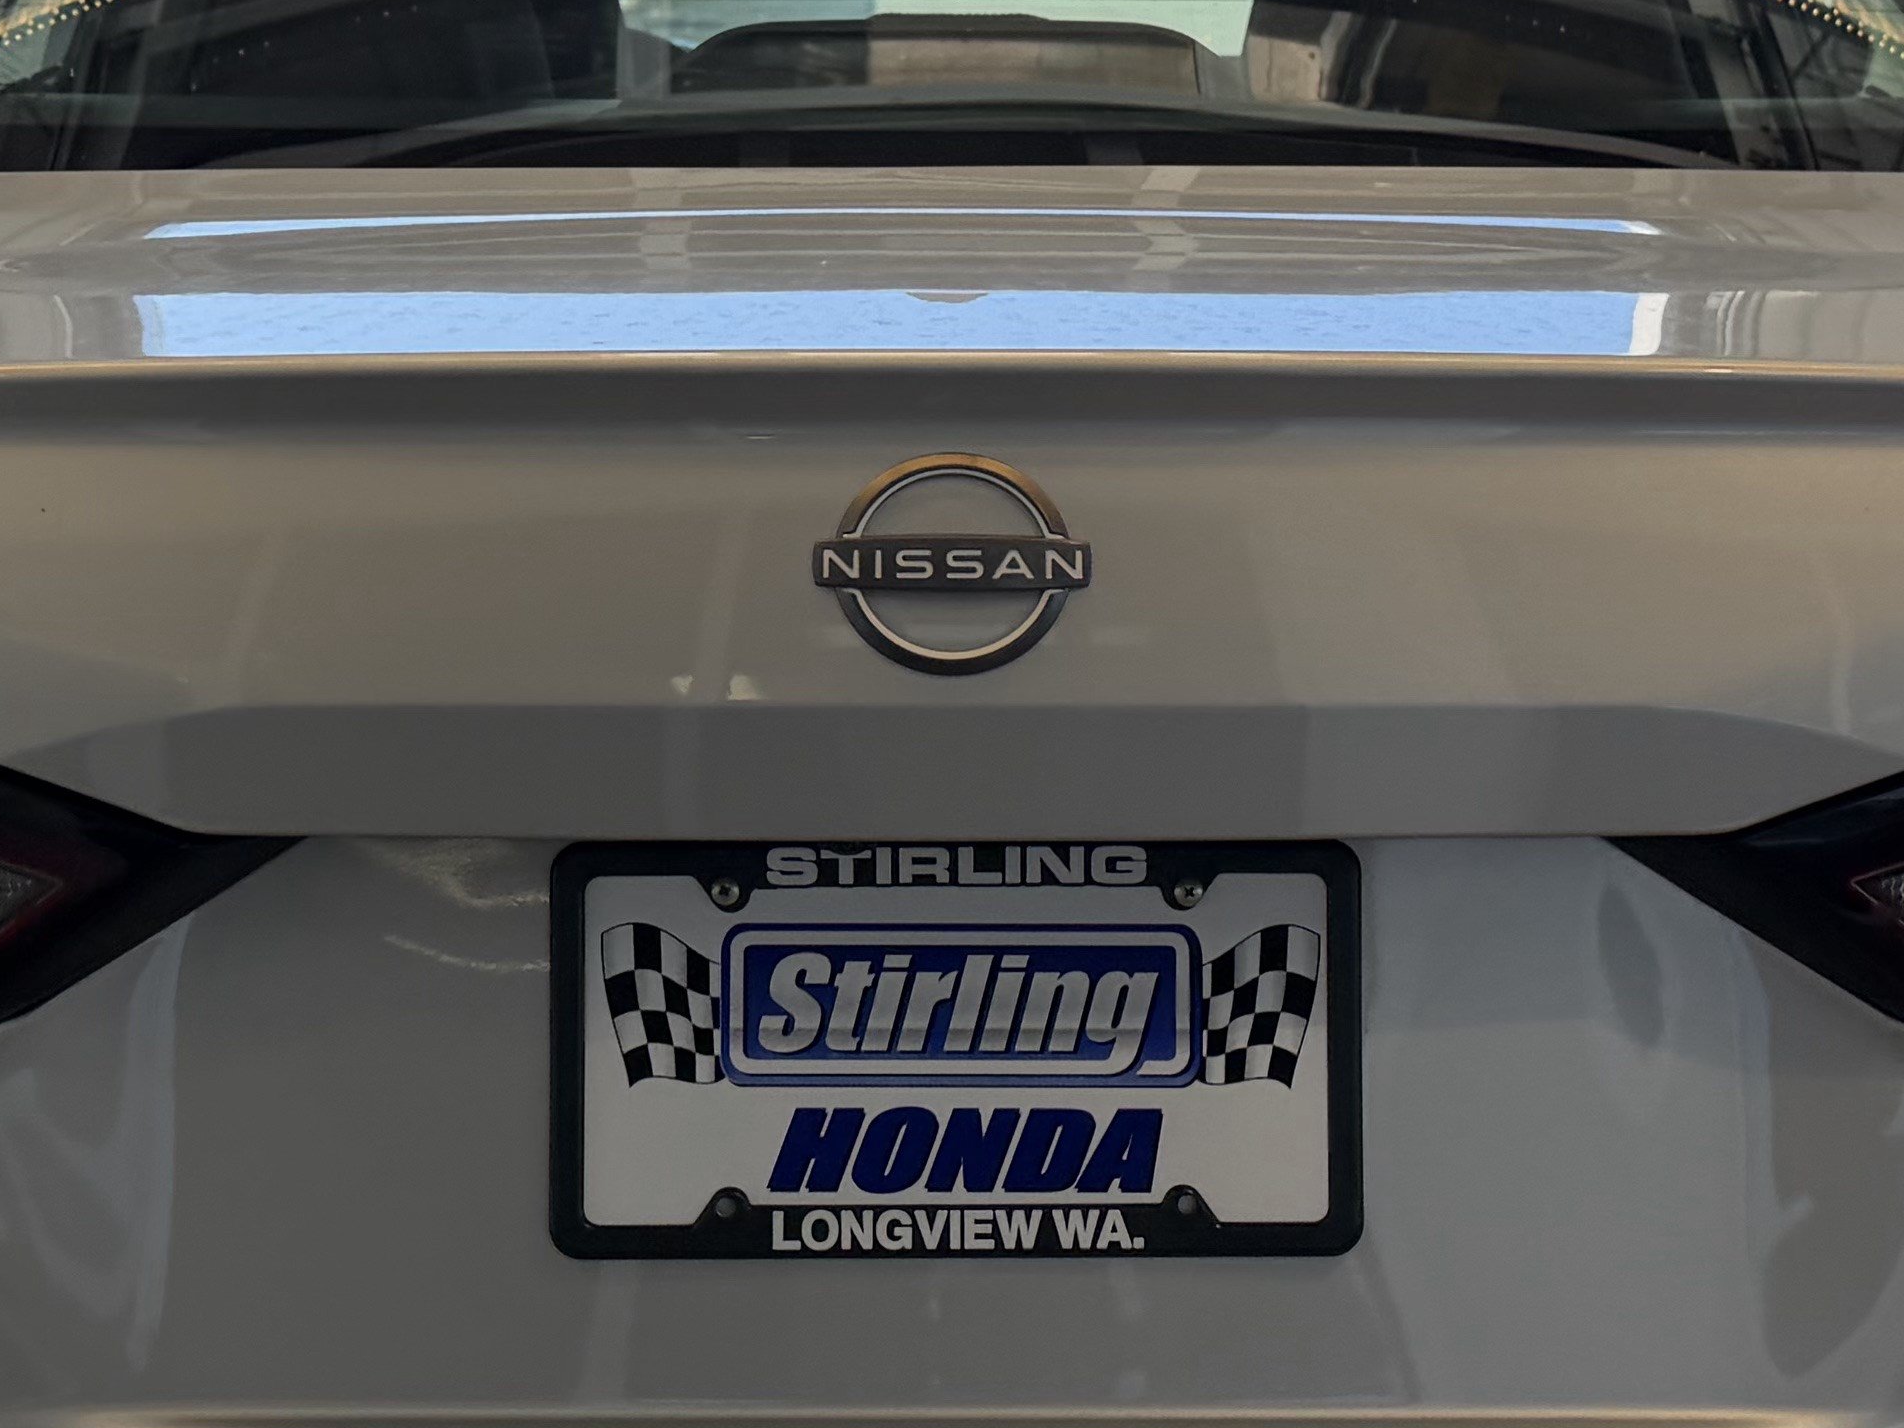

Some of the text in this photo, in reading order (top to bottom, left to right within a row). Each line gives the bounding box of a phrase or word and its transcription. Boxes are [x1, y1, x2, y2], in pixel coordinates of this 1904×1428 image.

[821, 548, 1084, 580] NISSAN
[766, 846, 1147, 885] STIRLING
[757, 950, 1161, 1075] Stirling
[767, 1106, 1164, 1194] HONDA
[772, 1209, 1146, 1250] LONGVIEW WA.
